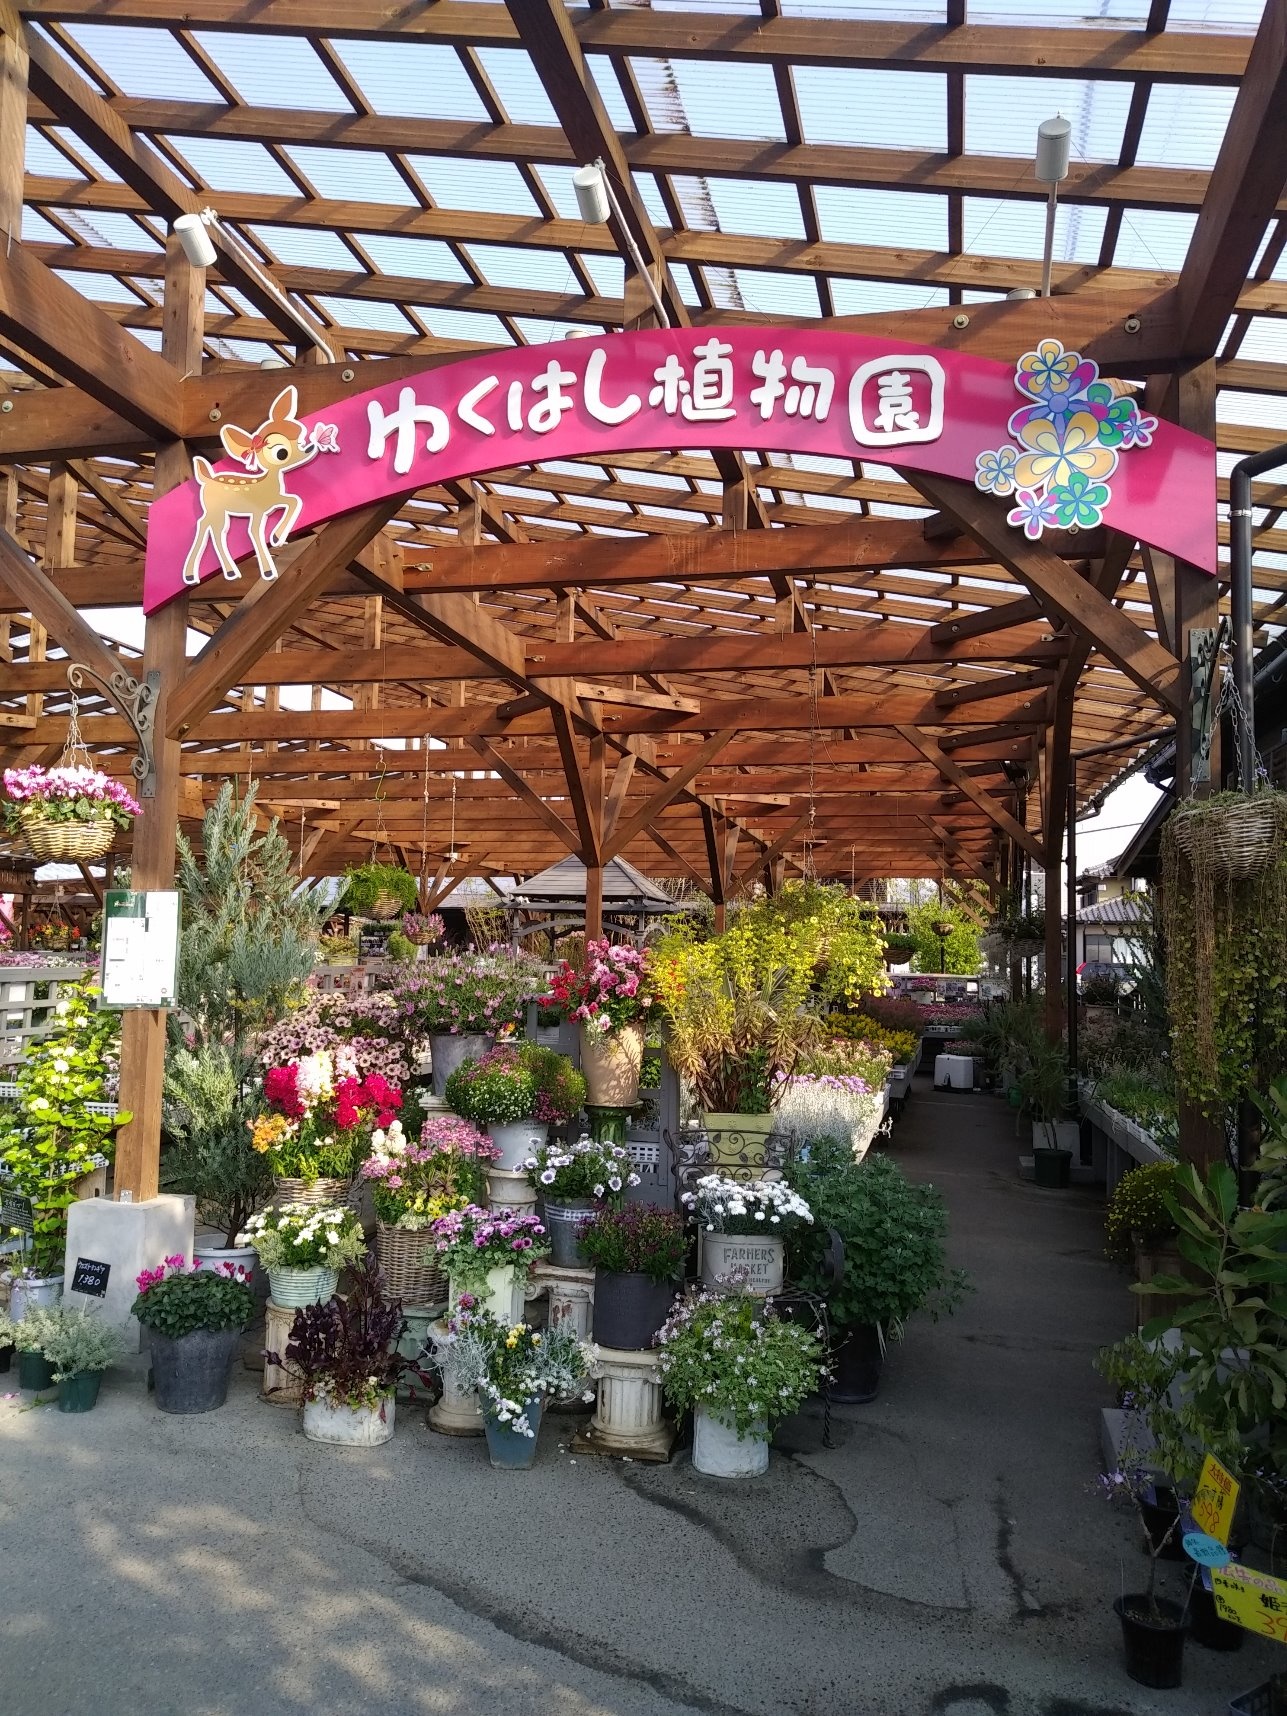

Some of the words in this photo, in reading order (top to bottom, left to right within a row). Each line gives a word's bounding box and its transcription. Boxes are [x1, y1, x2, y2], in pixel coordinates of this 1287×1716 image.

[367, 338, 946, 474] ゆくはし植物園
[723, 1247, 775, 1264] FARMERS
[77, 1274, 101, 1287] 1380
[1209, 1463, 1233, 1493] 大特価
